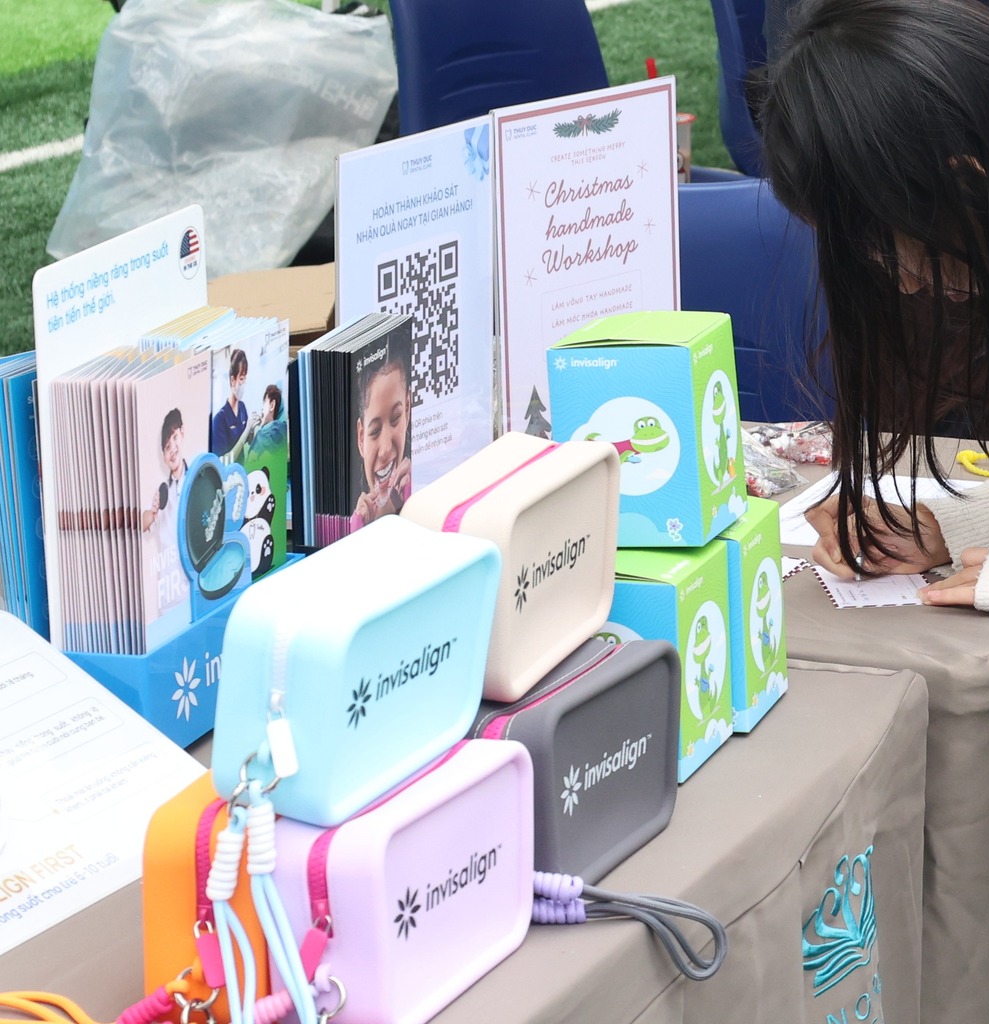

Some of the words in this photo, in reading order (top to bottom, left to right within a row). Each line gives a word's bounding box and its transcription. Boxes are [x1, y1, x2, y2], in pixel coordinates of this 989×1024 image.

[550, 152, 571, 163] CREATE
[573, 145, 606, 158] SOMETHING
[606, 141, 626, 152] MERRY
[571, 158, 584, 166] THIS
[585, 153, 607, 164] SEASON
[372, 202, 395, 221] HOÀN
[396, 194, 422, 213] THÀNH
[422, 186, 444, 207] KHẢO
[444, 182, 459, 200] SÁT
[544, 174, 634, 208] Christmas
[356, 225, 379, 244] NHẬN
[397, 215, 418, 232] NGAY
[419, 211, 430, 227] TẠI
[430, 206, 449, 222] GIAN
[545, 198, 634, 241] handmade
[541, 234, 639, 274] Workshop
[46, 292, 59, 309] Hệ
[60, 281, 85, 299] thống
[86, 271, 109, 292] niềng
[110, 264, 129, 280] răng
[130, 252, 151, 272] trong
[152, 241, 169, 261] suốt
[585, 292, 599, 303] TAY
[599, 284, 633, 298] HANDMADE
[82, 294, 97, 314] thế
[600, 301, 633, 316] HANDMADE
[363, 347, 387, 367] invisalign
[570, 357, 618, 370] invisalign
[531, 537, 587, 589] invisalign
[376, 640, 451, 702] invisalign
[584, 736, 647, 791] invisalign
[29, 843, 84, 880] FIRST
[426, 848, 497, 912] invisalign
[17, 894, 44, 913] suốt
[41, 885, 63, 900] cho
[73, 863, 100, 881] 6-10
